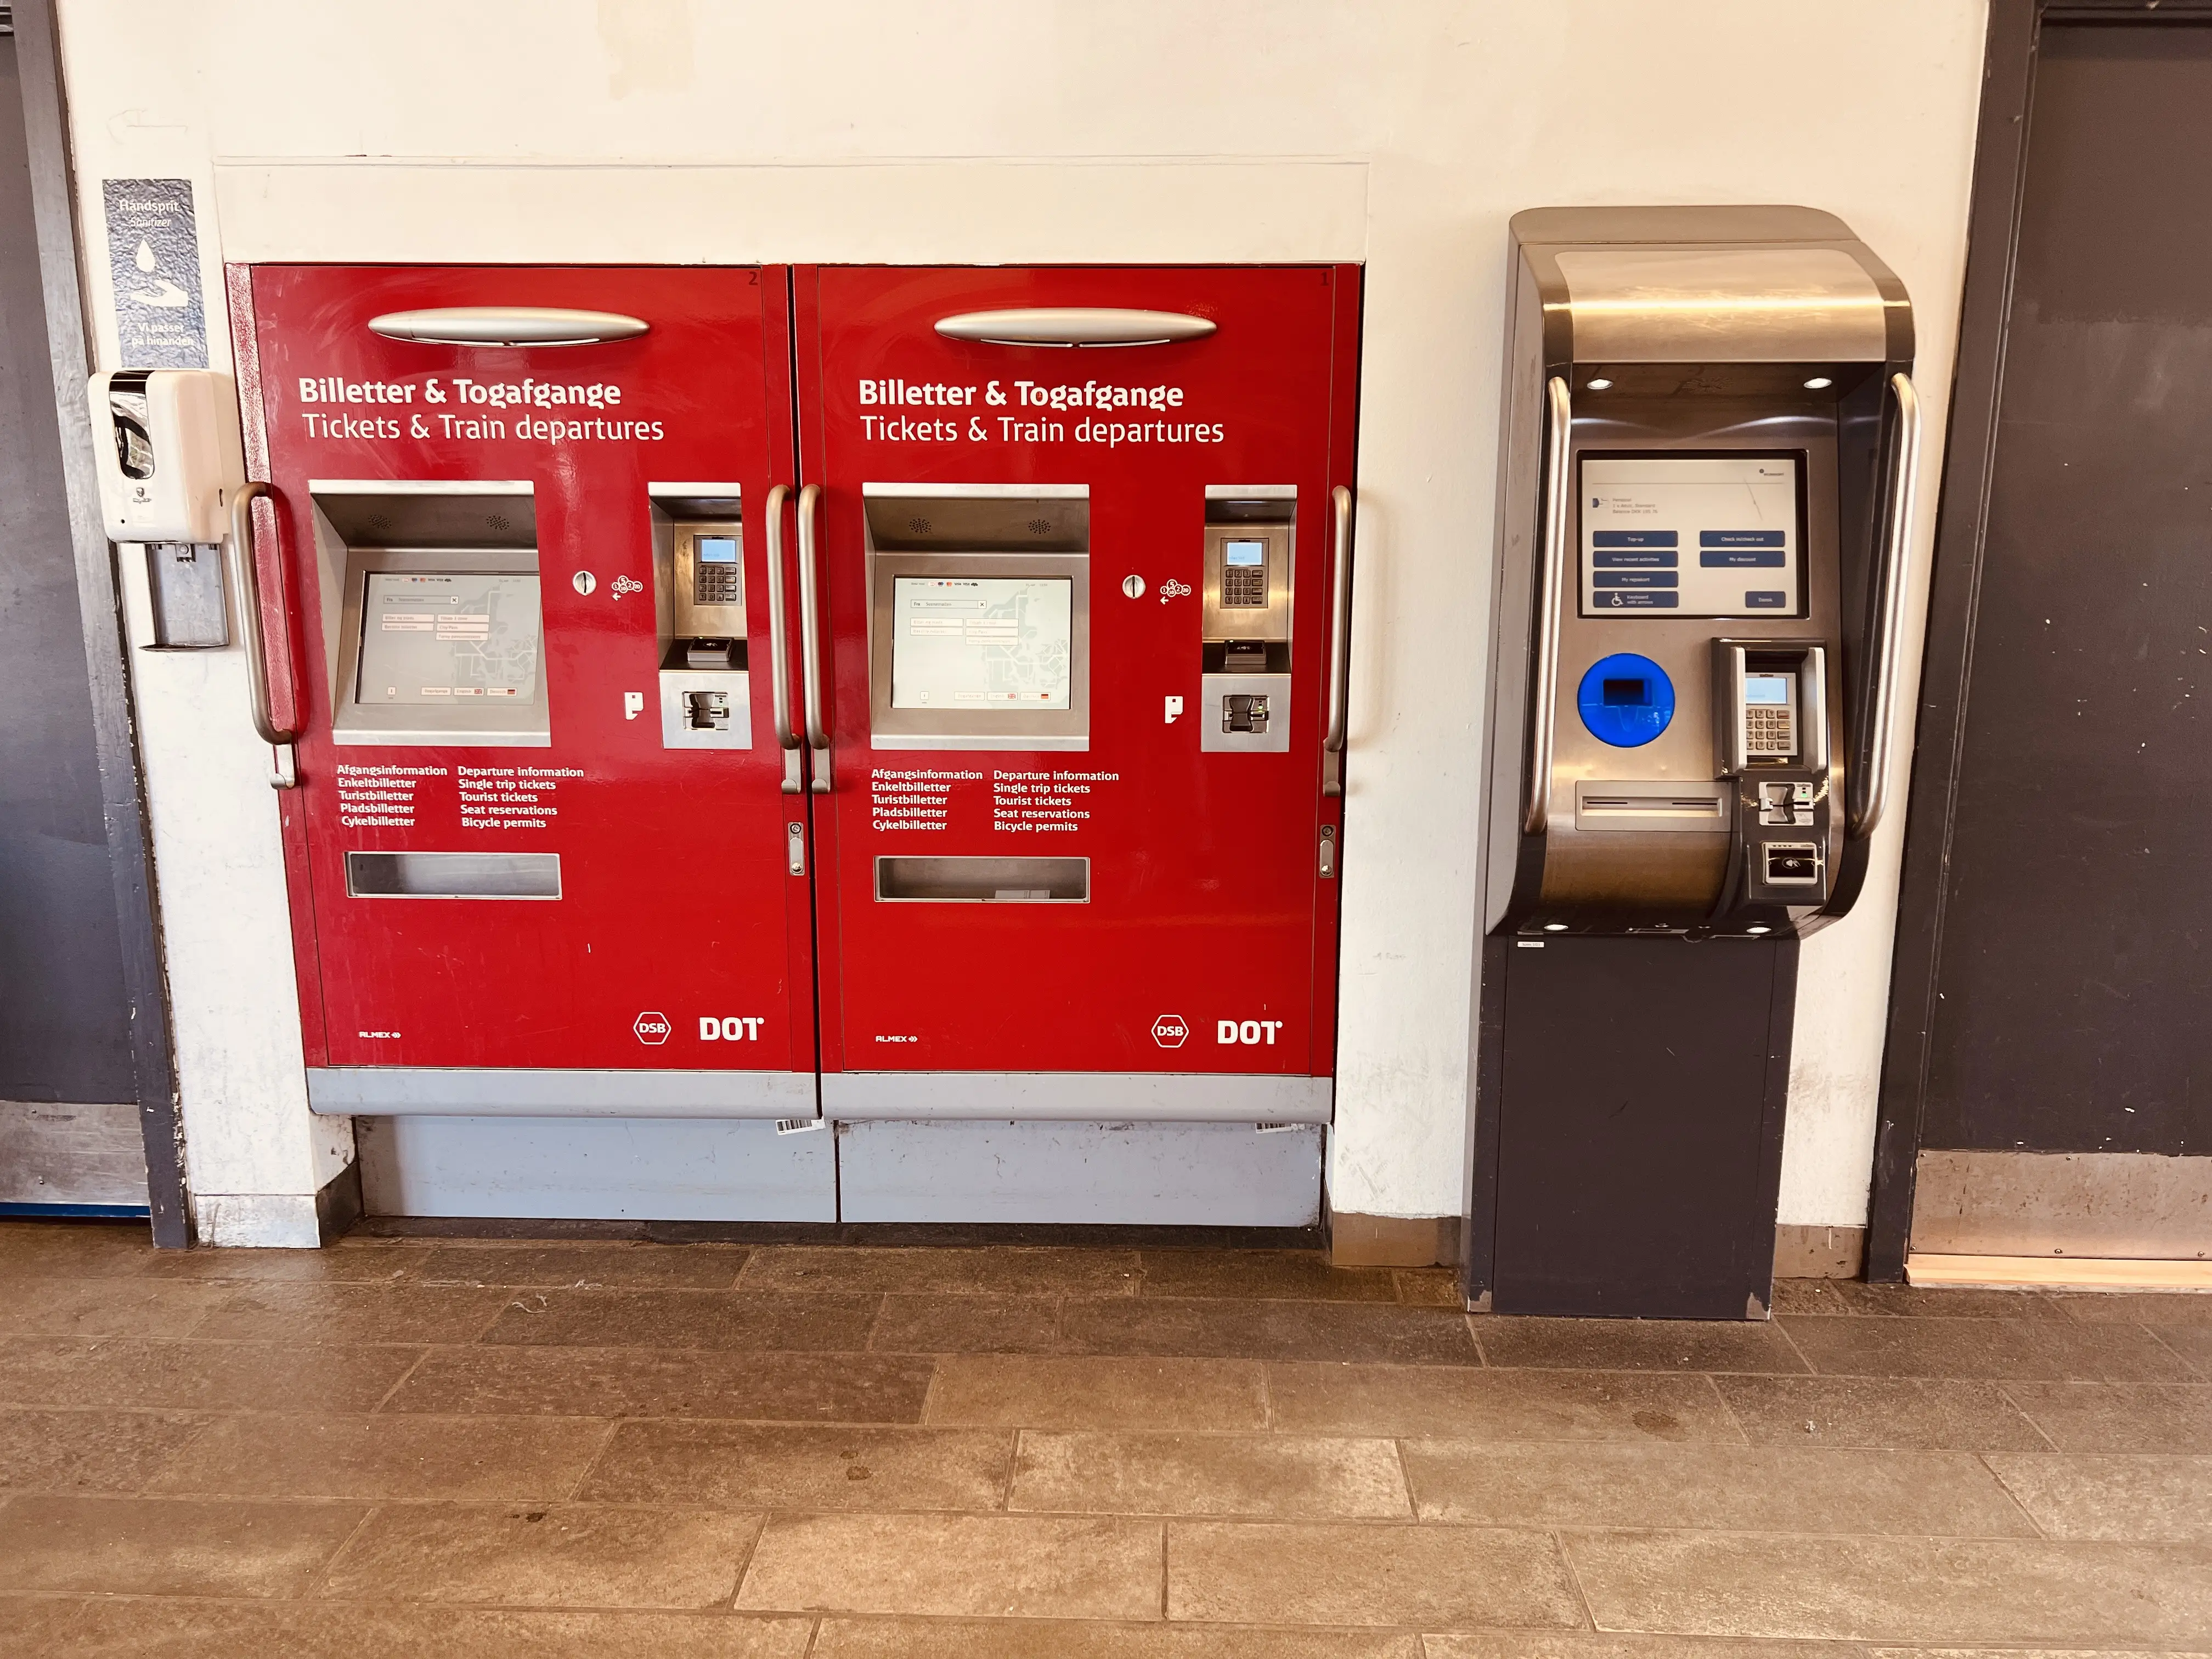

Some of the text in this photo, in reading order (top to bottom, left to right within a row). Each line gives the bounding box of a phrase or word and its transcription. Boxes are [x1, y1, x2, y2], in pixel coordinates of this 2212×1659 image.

[119, 199, 179, 213] Håndsprit
[130, 218, 172, 228] Sanitizer
[748, 271, 758, 285] 2
[1321, 272, 1329, 286] 1
[138, 322, 184, 334] Vi passer
[132, 335, 194, 347] på hinanden
[298, 377, 621, 410] Billetter & Togafgange
[859, 379, 1183, 412] Billetter & Togafgange
[301, 413, 664, 445] Tickets & Train departures
[860, 415, 1224, 448] Tickets & Train departures
[337, 764, 448, 777] Afgangsinformation
[458, 766, 584, 778] Departure information
[871, 769, 983, 781] Afgangsinformation
[994, 770, 1119, 782] Departure information
[338, 777, 417, 788] Enkeltbilletter
[458, 778, 556, 791] Single trip tickets
[872, 781, 951, 792] Enkeltbilletter
[994, 782, 1091, 795] Single trip tickets
[338, 790, 414, 801] Turistbilletter
[459, 792, 538, 802] Tourist tickets
[871, 794, 947, 805] Turistbilletter
[993, 795, 1071, 806] Tourist tickets
[340, 803, 415, 814] Pladsbilletter
[460, 804, 558, 815] Seat reservations
[872, 807, 947, 817] Pladsbilletter
[994, 808, 1090, 819] Seat reservations
[341, 815, 415, 828] Cykelbilletter
[461, 817, 546, 830] Bicycle permits
[872, 820, 947, 832] Cykelbilletter
[994, 821, 1078, 833] Bicycle permits
[638, 1023, 666, 1033] DSB
[699, 1017, 765, 1041] DOT
[1157, 1026, 1184, 1036] DSB
[1217, 1020, 1283, 1045] DOT
